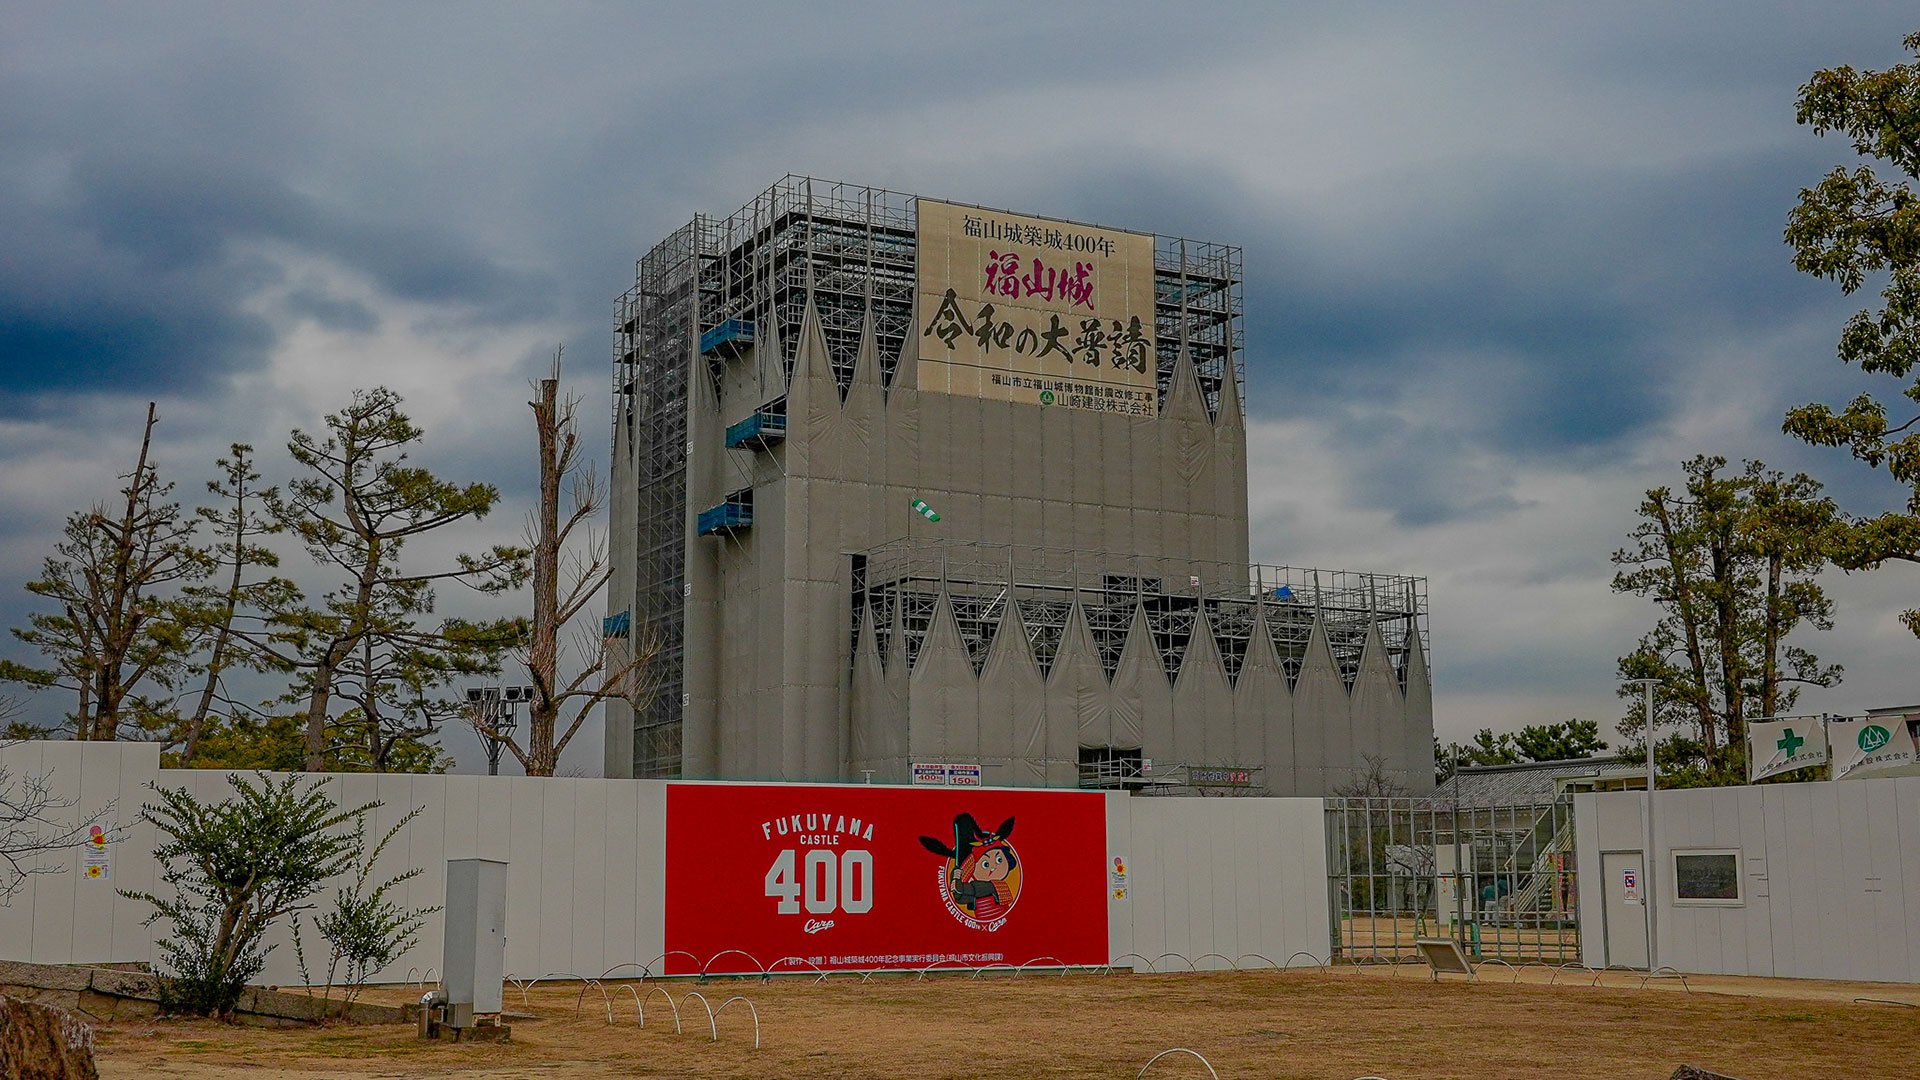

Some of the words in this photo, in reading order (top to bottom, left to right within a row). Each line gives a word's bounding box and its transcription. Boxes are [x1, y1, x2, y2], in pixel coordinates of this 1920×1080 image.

[963, 214, 1116, 258] 福山城築城400年
[983, 250, 1095, 311] 福山城
[923, 288, 1152, 375] 令和の大普請
[991, 373, 1153, 402] 福山市立福山城博物館耐震改修工事
[1057, 393, 1154, 417] 山崎建設株式会社
[761, 813, 874, 841] FUKUYAMA
[800, 834, 839, 845] CASTLE
[765, 849, 873, 914] 400
[937, 865, 949, 902] FUKUYAMA
[945, 901, 966, 924] CASTLE
[804, 918, 835, 934] Carp
